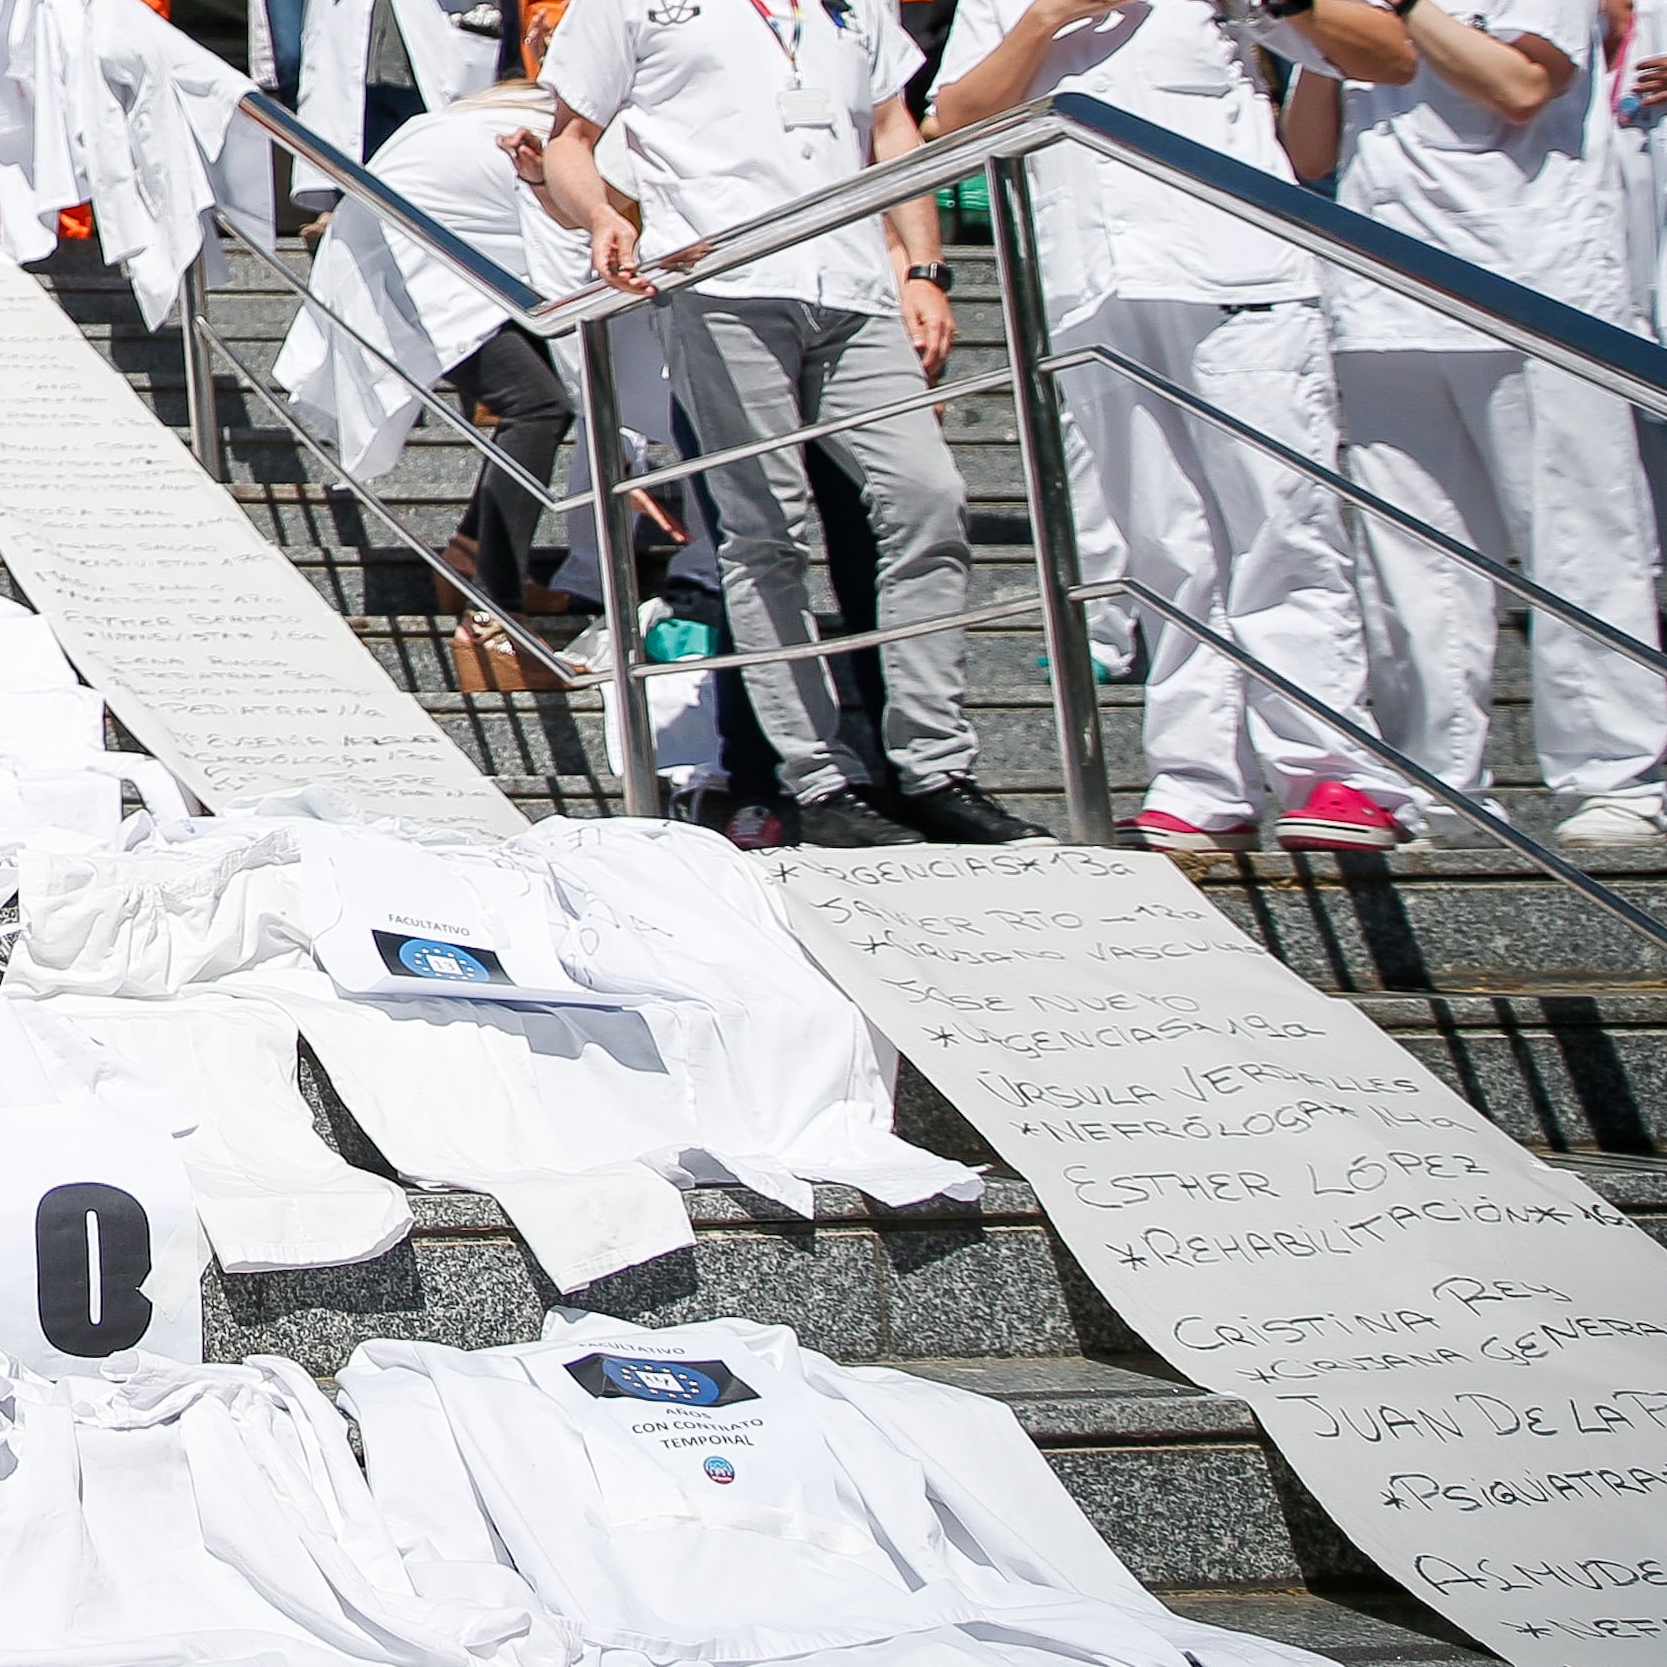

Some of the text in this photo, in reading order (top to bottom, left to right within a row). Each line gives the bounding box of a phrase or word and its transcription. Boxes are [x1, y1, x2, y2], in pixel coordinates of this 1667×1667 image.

[388, 913, 472, 937] FACULTATIVO
[1063, 1151, 1492, 1209] ESTHER LÓPEZ
[631, 1417, 764, 1434] CON CONTRATO
[666, 1407, 712, 1420] AÑOS
[1275, 1393, 1464, 1443] JUAN
[1454, 1392, 1558, 1436] DE
[659, 1433, 755, 1450] TEMPORAL
[1391, 1465, 1664, 1512] PSIQUIATRA
